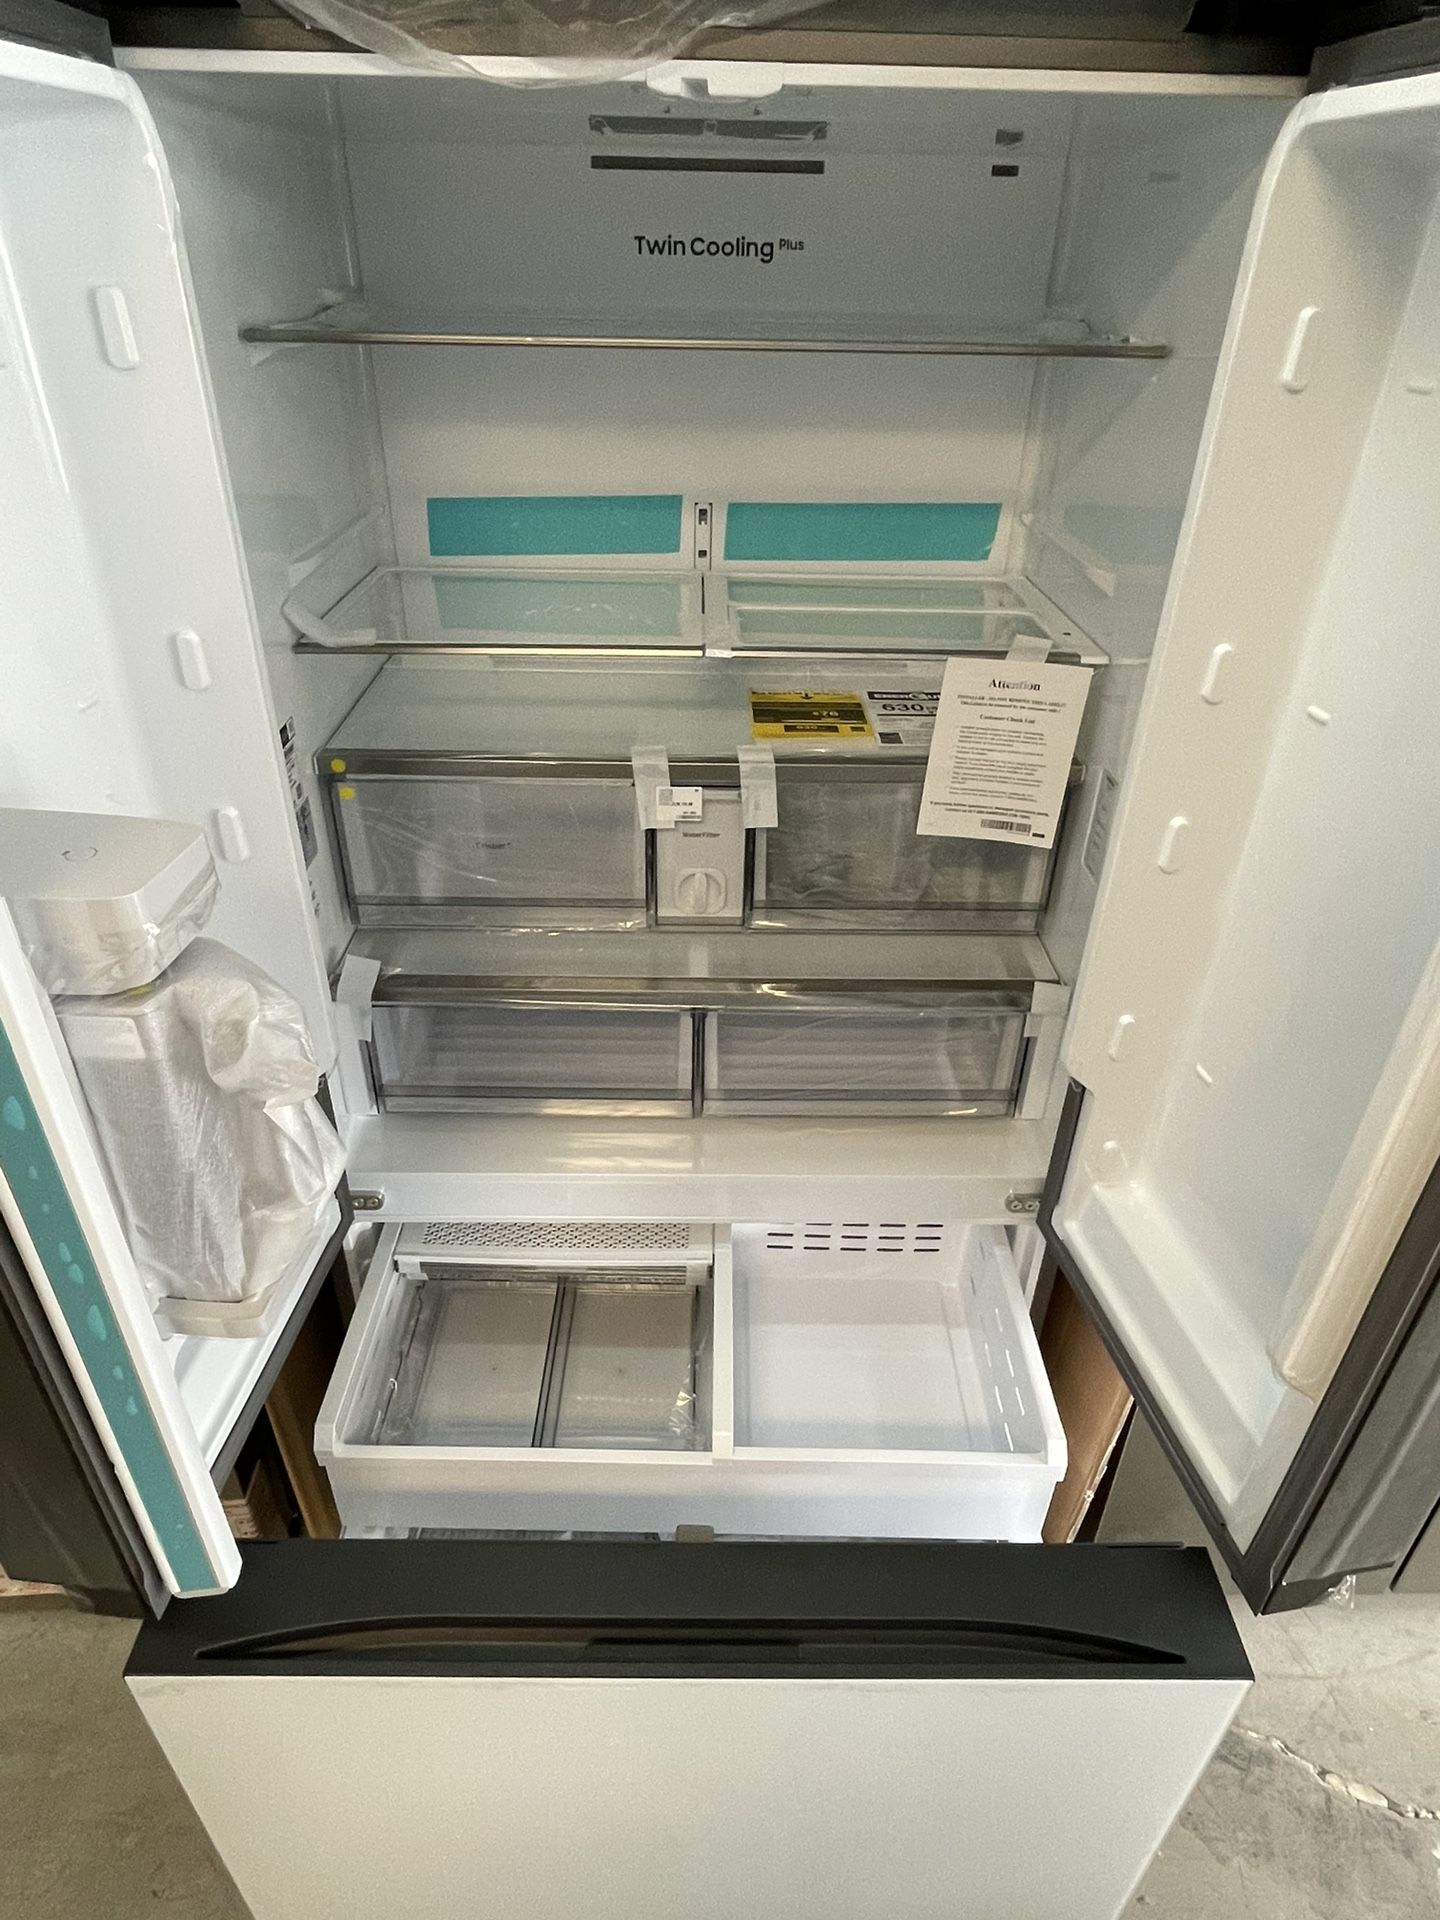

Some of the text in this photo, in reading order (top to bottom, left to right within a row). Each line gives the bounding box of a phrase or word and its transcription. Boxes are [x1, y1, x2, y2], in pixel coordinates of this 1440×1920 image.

[634, 234, 805, 264] Twin Cooling Plus
[988, 679, 1041, 691] Attention
[882, 703, 924, 712] 630
